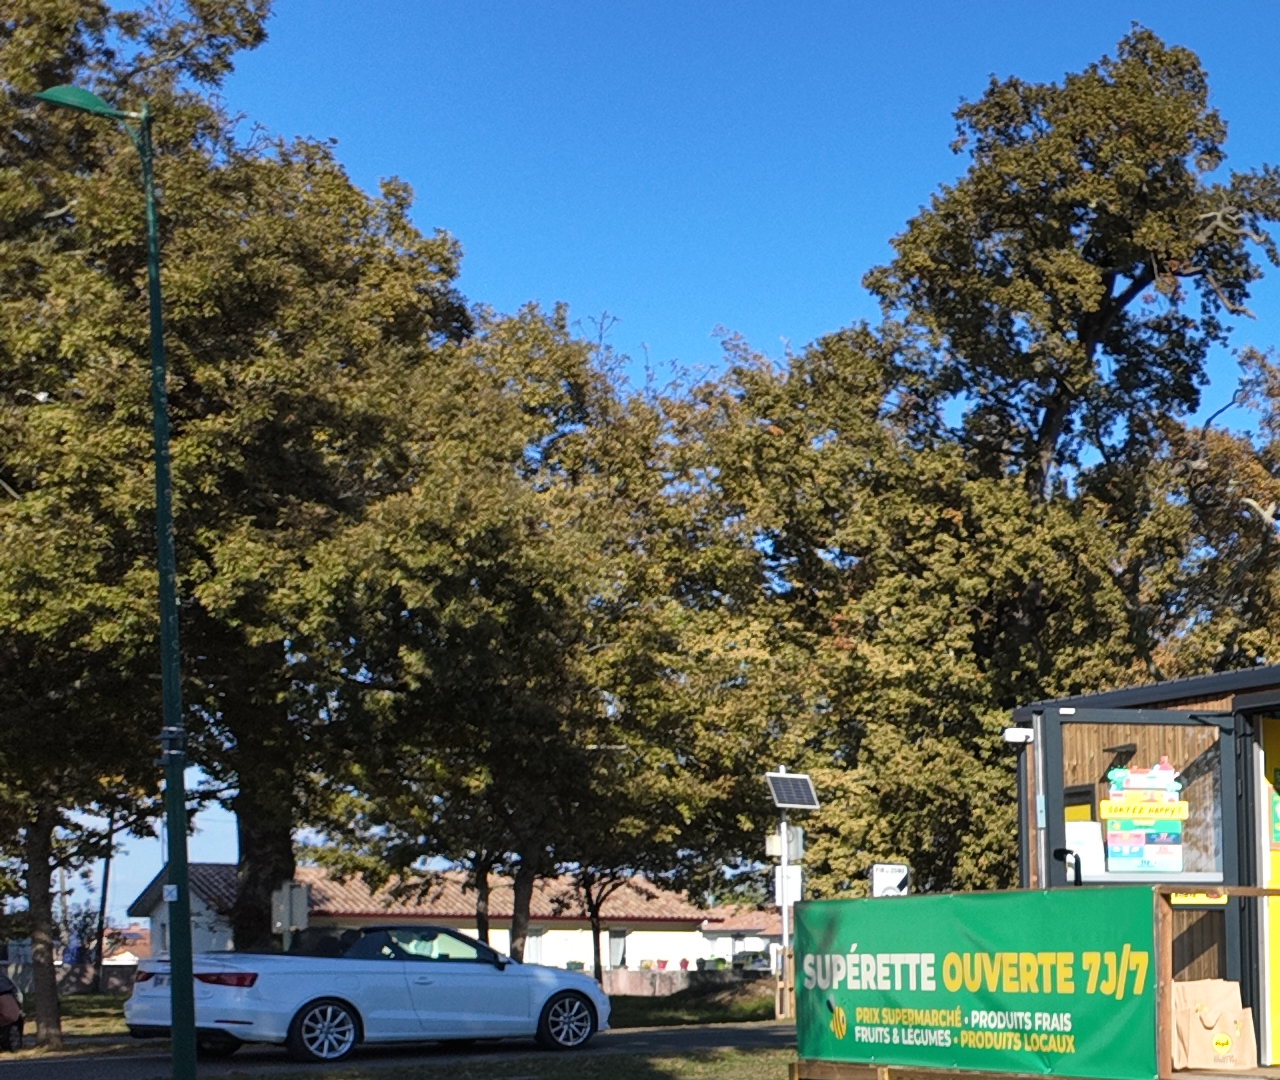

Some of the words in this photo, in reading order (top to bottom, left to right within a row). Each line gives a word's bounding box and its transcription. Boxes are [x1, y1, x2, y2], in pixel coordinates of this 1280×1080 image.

[803, 943, 936, 992] SUPÉRETTE
[942, 951, 1075, 994] OUVERTE
[1081, 943, 1149, 1000] 7J/7
[855, 1006, 881, 1024] PRIX
[881, 1005, 962, 1028] SUPERMARCHÉ
[970, 1010, 1032, 1030] PRODUITS
[1034, 1012, 1072, 1032] FRAIS
[854, 1026, 891, 1044] FRUITS
[892, 1028, 900, 1045] &
[901, 1025, 952, 1048] LÉGUMES
[960, 1032, 1021, 1051] PRODUITS
[1023, 1034, 1075, 1053] LOCAUX
